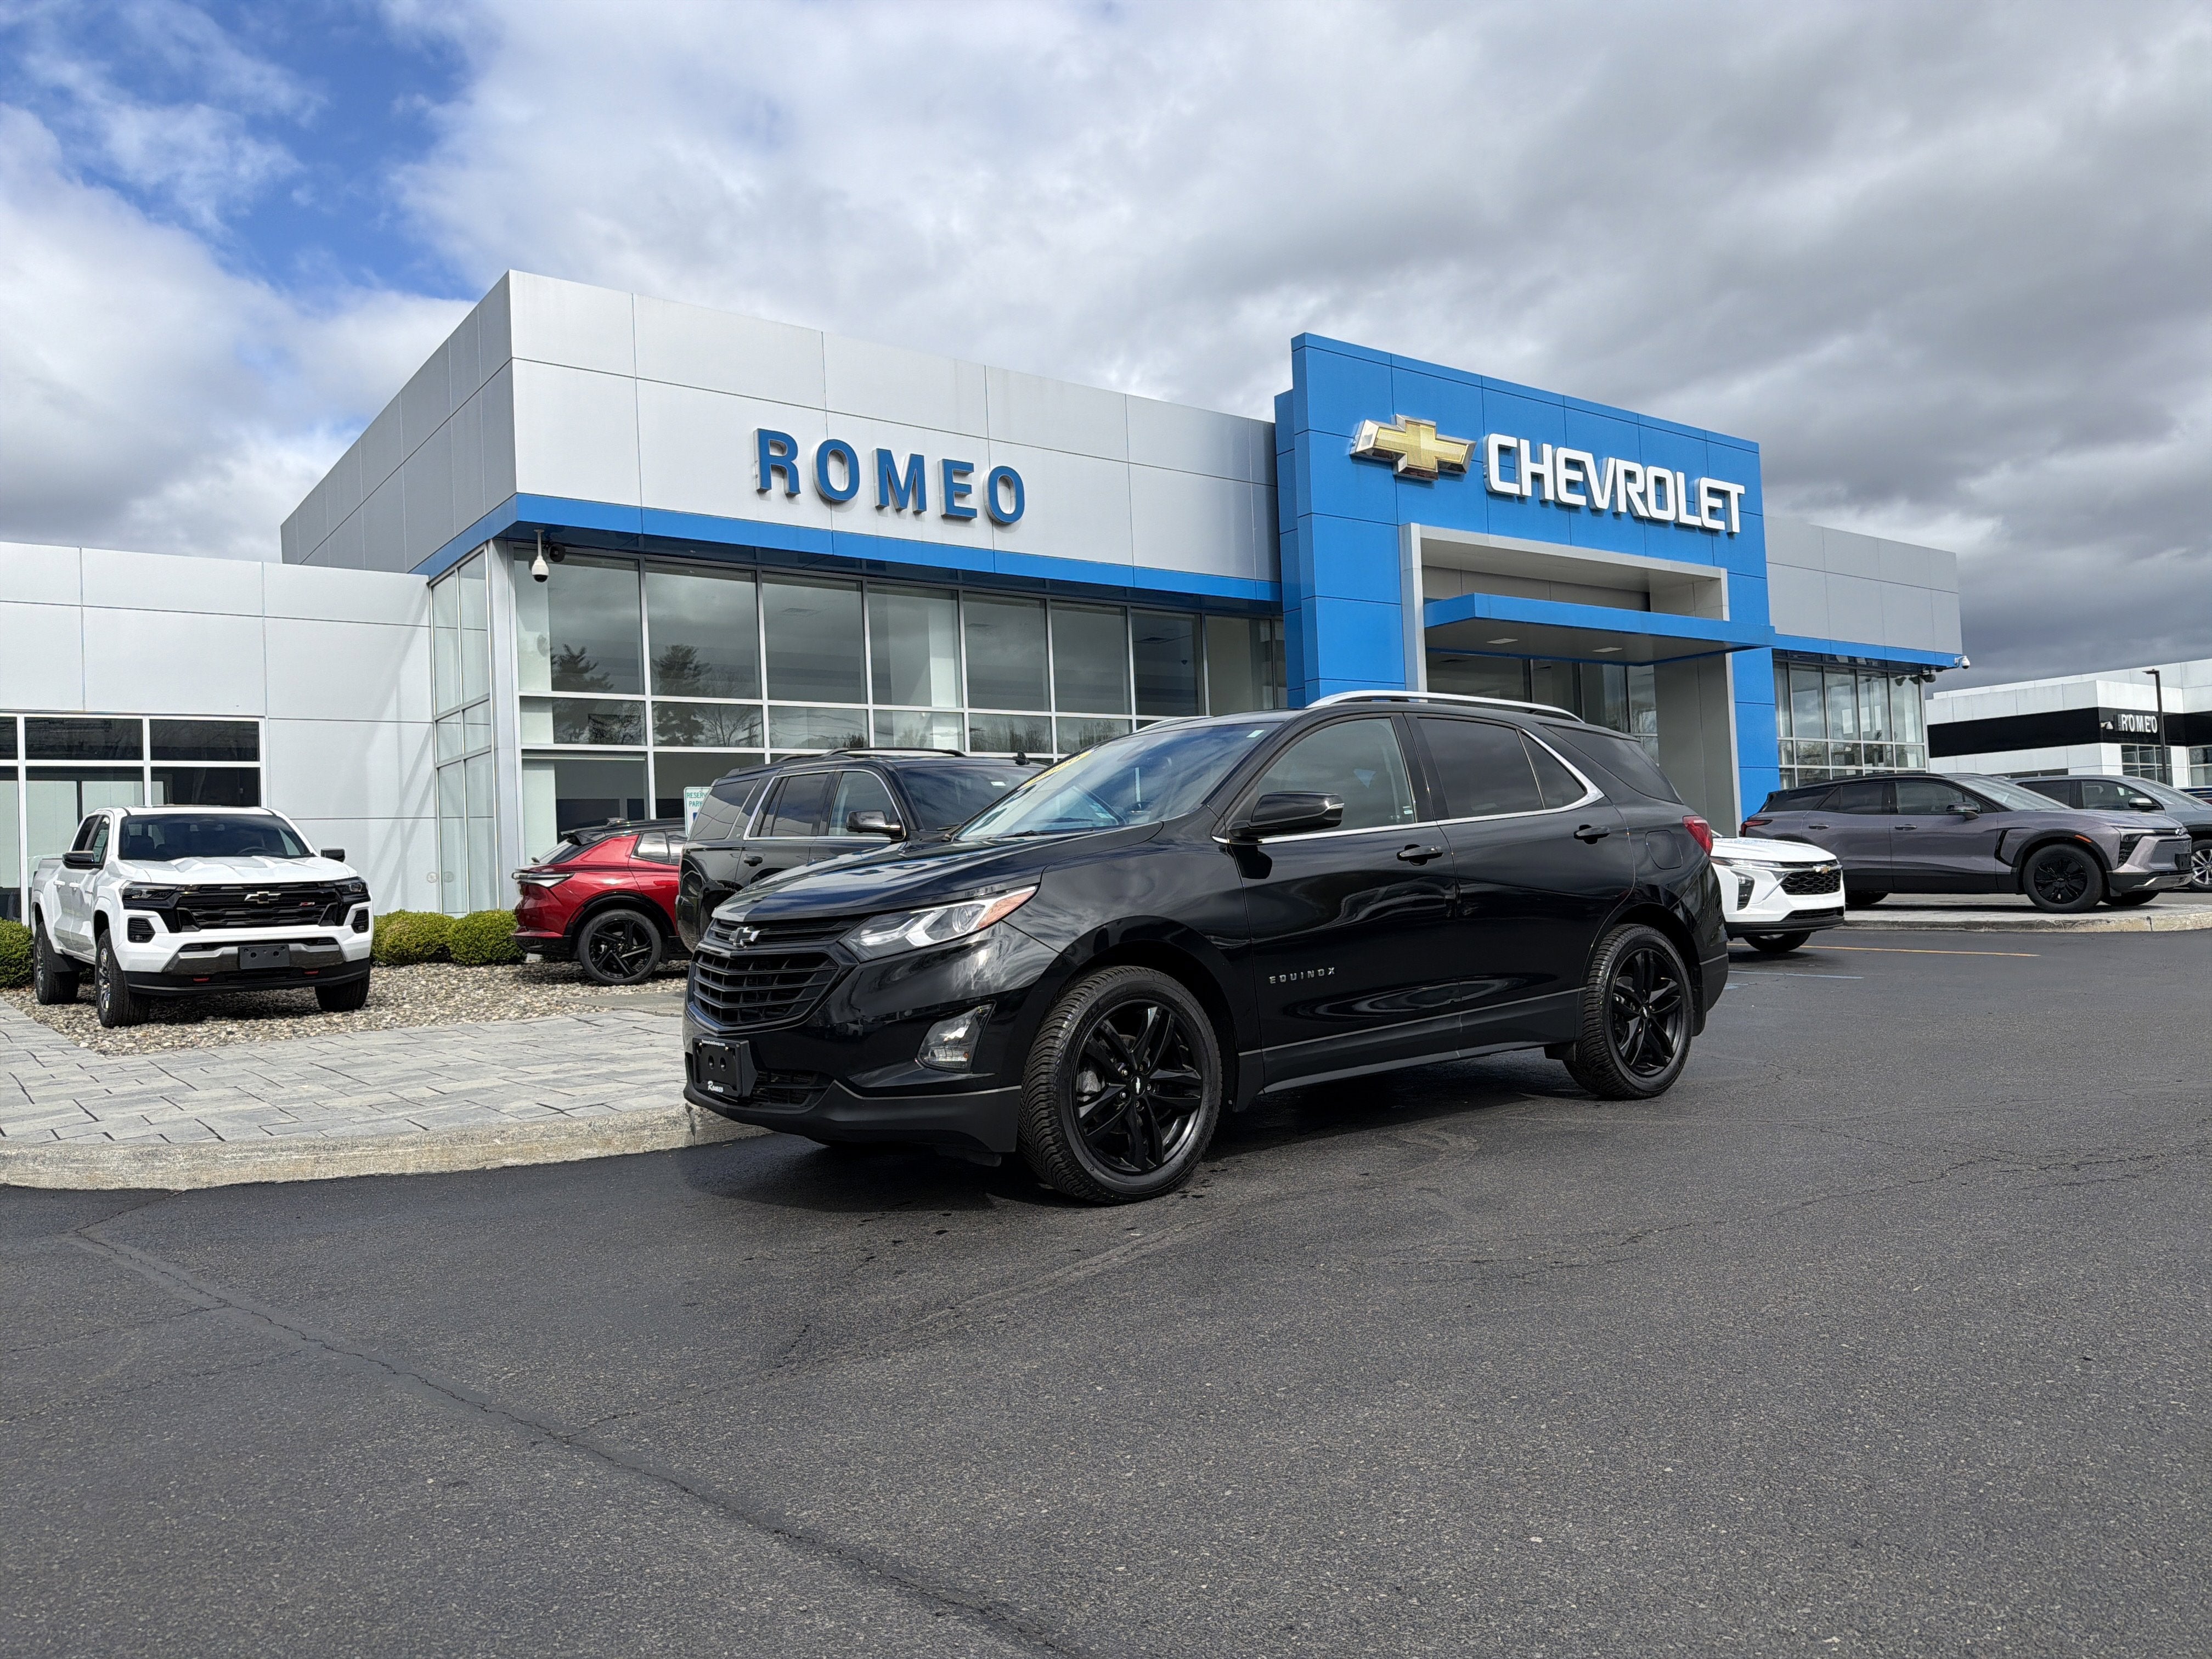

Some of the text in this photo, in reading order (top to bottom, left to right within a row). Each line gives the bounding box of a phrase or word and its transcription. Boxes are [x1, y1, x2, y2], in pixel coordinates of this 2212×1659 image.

[754, 428, 1025, 524] ROMEO
[1483, 433, 1745, 534] CHEVROLET
[2121, 714, 2158, 733] ROMEO
[1268, 967, 1335, 984] EQUINOX
[708, 1080, 724, 1093] Romeo
